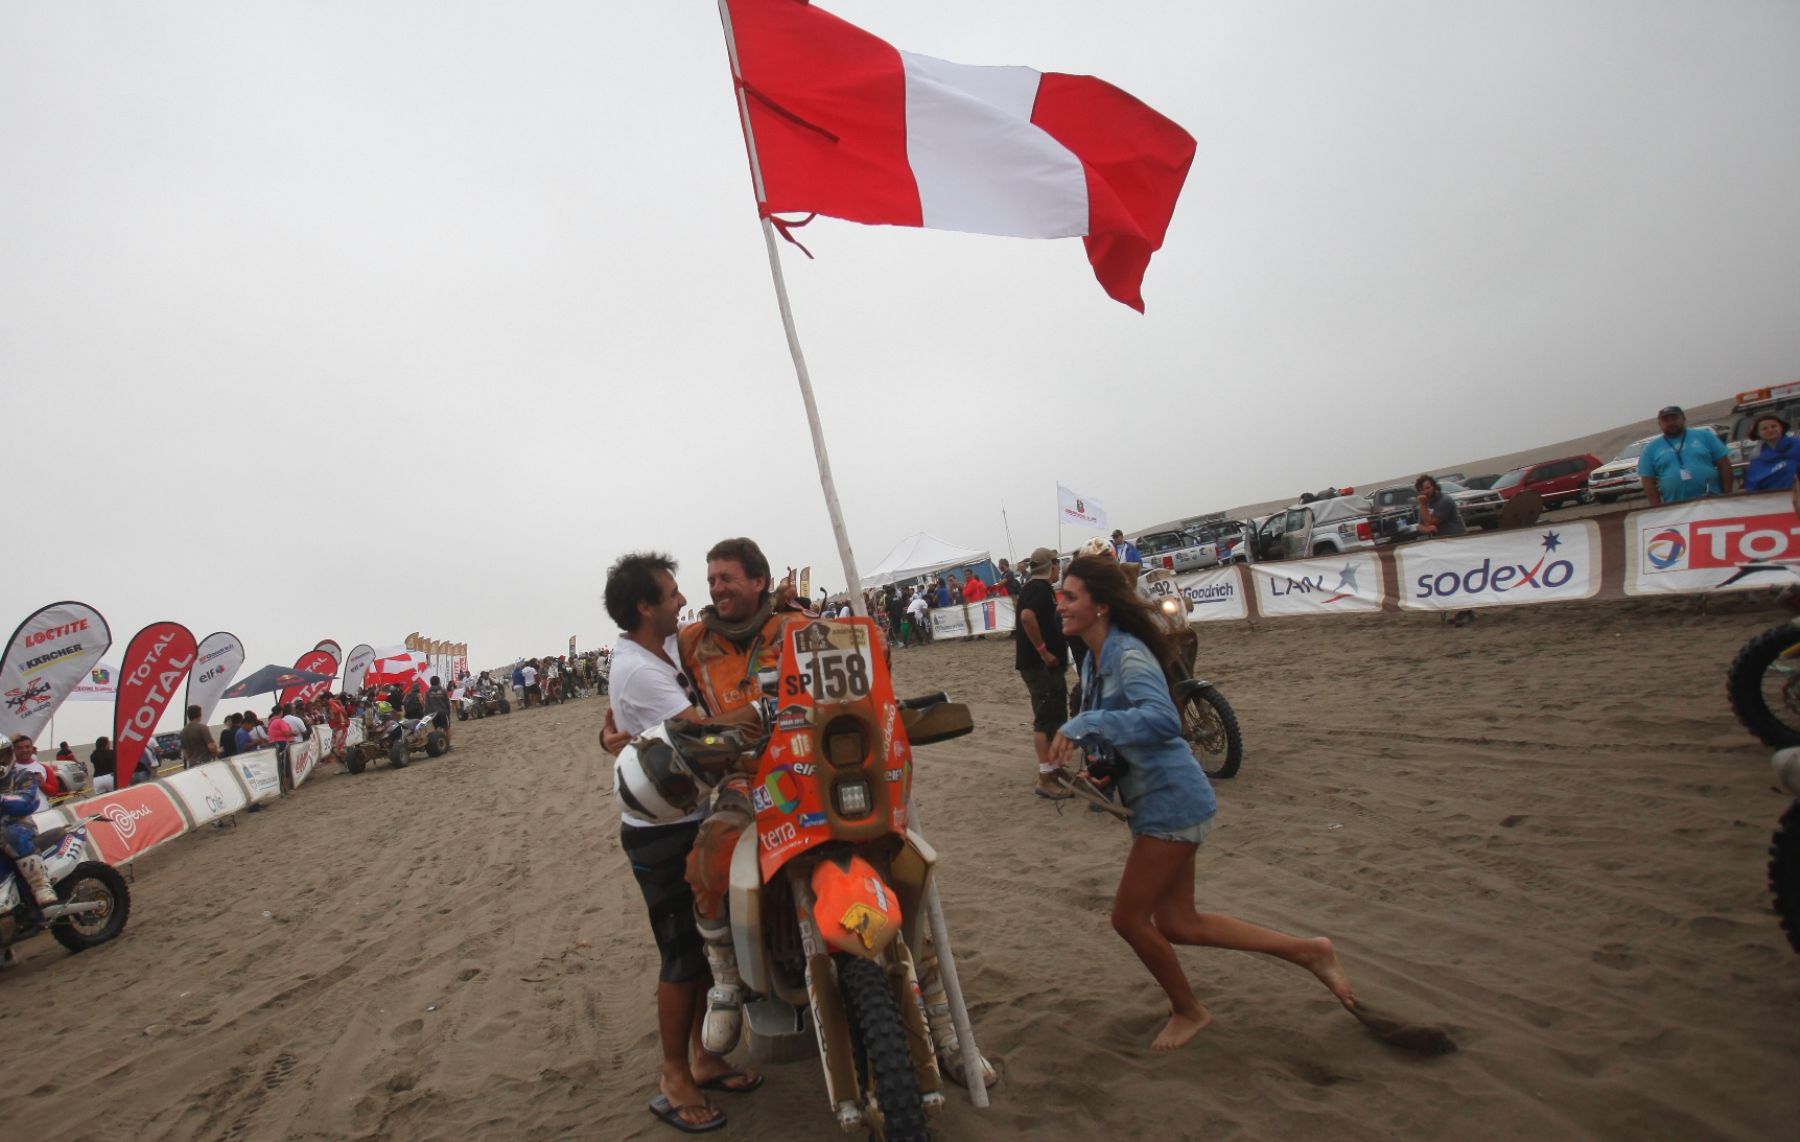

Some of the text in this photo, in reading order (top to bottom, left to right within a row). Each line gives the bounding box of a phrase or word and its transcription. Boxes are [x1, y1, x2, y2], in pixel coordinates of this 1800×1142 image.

[1697, 523, 1800, 561] TO
[1270, 575, 1324, 596] LAN
[1416, 556, 1574, 598] sodexo
[1154, 581, 1173, 597] 92
[25, 619, 89, 648] LOCTITE
[126, 632, 176, 687] TOTAL
[304, 657, 328, 673] TAL
[199, 667, 215, 684] elf
[785, 673, 812, 696] SP
[805, 654, 870, 700] 158
[118, 653, 193, 743] TOTAL
[793, 762, 817, 776] elf
[886, 769, 902, 781] elf
[760, 821, 796, 851] terra
[66, 842, 82, 860] 111
